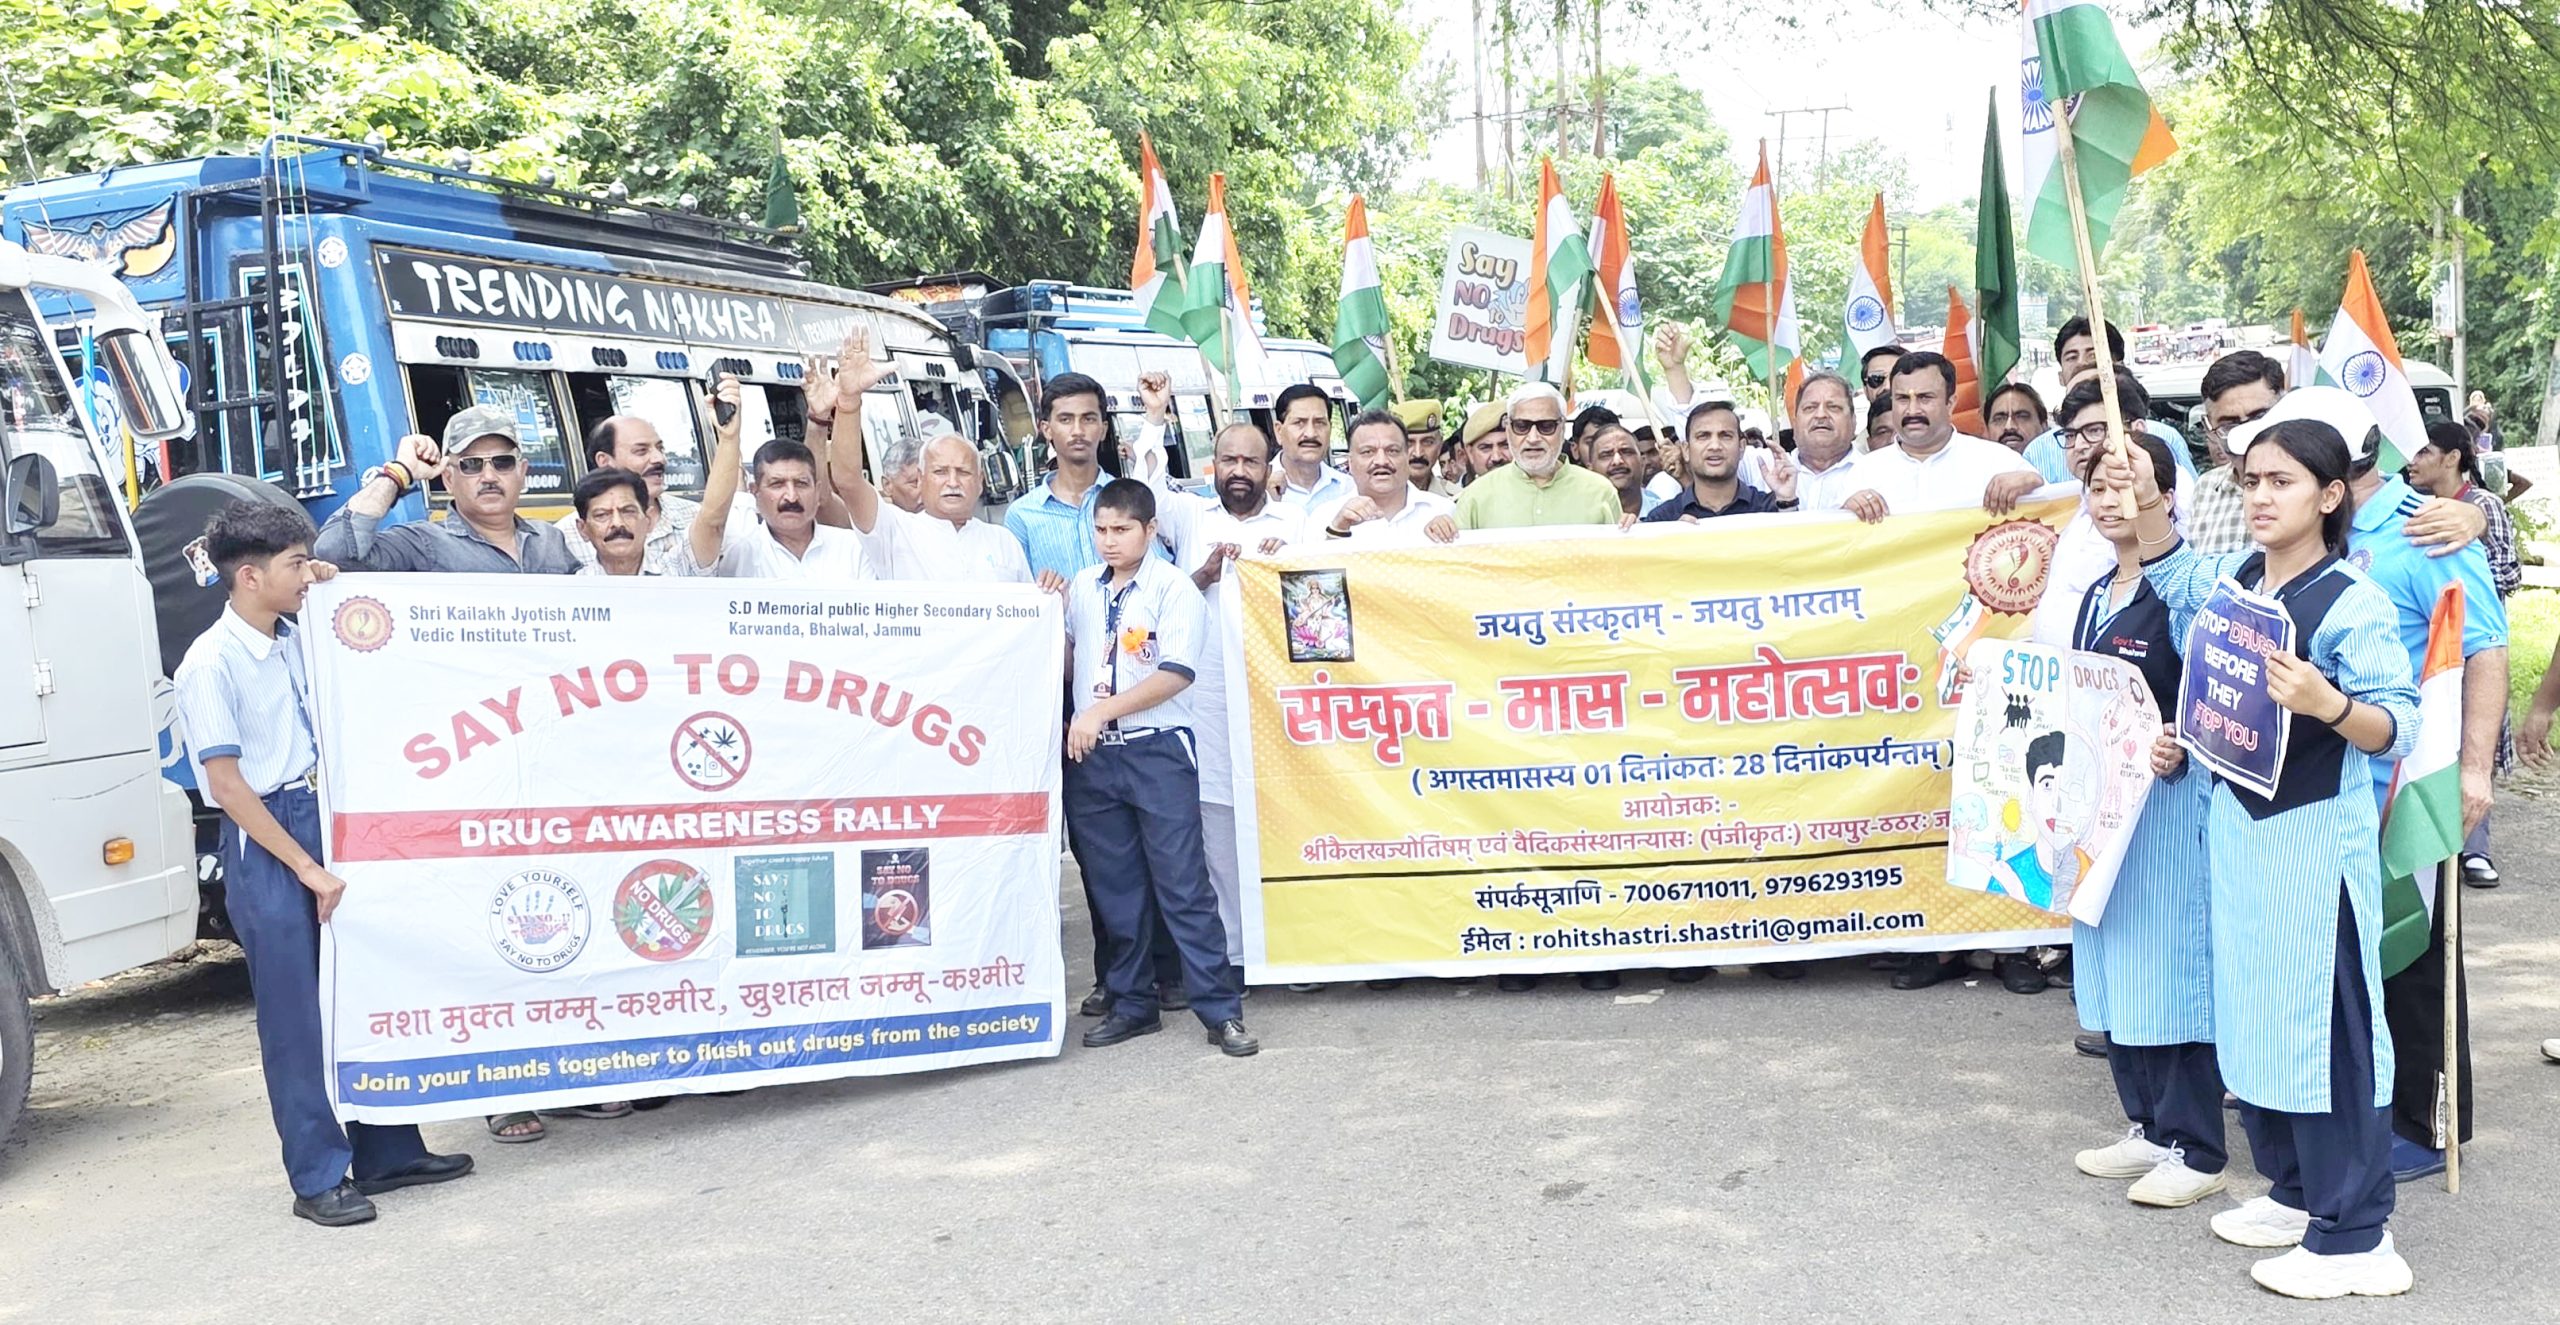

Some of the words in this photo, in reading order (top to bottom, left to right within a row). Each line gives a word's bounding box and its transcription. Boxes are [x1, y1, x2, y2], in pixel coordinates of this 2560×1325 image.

[1458, 241, 1517, 290] Say
[412, 261, 637, 332] TRENDING
[643, 288, 776, 342] NAKHRA
[1453, 279, 1491, 310] NO
[1488, 307, 1505, 324] to
[1448, 312, 1526, 356] Drugs
[521, 474, 562, 493] ueen
[409, 605, 441, 621] Shri
[447, 605, 506, 622] Kailakh
[511, 606, 567, 623] Jyotish
[572, 607, 611, 622] AVIM
[729, 601, 752, 616] S.D
[757, 601, 823, 617] Memorial
[828, 602, 870, 618] public
[875, 603, 919, 619] Higher
[923, 604, 992, 620] Secondary
[996, 604, 1041, 619] School
[729, 621, 805, 638] Karwanda,
[809, 622, 869, 638] Bhalwal,
[873, 622, 922, 637] Jammu
[1475, 610, 1547, 645] जयतु
[1550, 602, 1667, 641] संस्कृतम्
[1690, 596, 1765, 631] जयतु
[1769, 587, 1864, 621] भारतम्
[2199, 608, 2230, 636] STOP
[410, 628, 455, 643] Vedic
[461, 628, 527, 644] Institute
[532, 629, 577, 644] Trust.
[2002, 649, 2060, 692] STOP
[2074, 665, 2120, 691] DRUGS
[2204, 642, 2259, 686] BEFORE
[2207, 676, 2243, 711] THEY
[403, 686, 526, 779] SAY
[550, 659, 648, 717] NO
[673, 652, 760, 696] TO
[784, 660, 986, 767] DRUGS
[1279, 672, 1453, 763] संस्कृत
[1500, 674, 1628, 732] मास
[2192, 699, 2222, 732] STOP
[2224, 717, 2258, 751] YOU
[1428, 765, 1576, 789] अगस्तमासस्य
[1584, 764, 1611, 785] 01
[1733, 754, 1765, 777] 28
[1772, 738, 1941, 774] दिनांकपर्यन्तम्
[460, 816, 572, 848] DRUG
[585, 808, 821, 842] AWARENESS
[833, 803, 944, 834] RALLY
[1477, 832, 1507, 855] एवं
[753, 873, 778, 887] SAY
[897, 865, 912, 875] NO
[1475, 879, 1601, 914] संपर्कसूत्राणि
[1624, 880, 1758, 903] 7006711011,
[1765, 867, 1903, 896] 9796293195
[493, 882, 516, 915] LOVE
[521, 872, 584, 911] YOURSELF
[629, 880, 650, 901] NO
[647, 898, 692, 945] DRUGS
[754, 891, 776, 903] NO
[755, 908, 774, 920] TO
[499, 938, 517, 957] SAY
[517, 954, 533, 966] NO
[536, 958, 551, 967] TO
[553, 934, 581, 963] DRUGS
[755, 922, 806, 937] DRUGS
[1461, 925, 1512, 954] ईमेल
[1533, 911, 1925, 952] rohitshastri.shastri1@gmail.com
[369, 1009, 433, 1039] नशा
[440, 1002, 515, 1044] मुक्त
[525, 978, 728, 1031] जम्मू-कश्मीर,
[738, 976, 850, 1018] खुशहाल
[859, 955, 1026, 1004] जम्मू-कश्मीर
[352, 1072, 412, 1092] Join
[417, 1069, 471, 1094] your
[477, 1058, 551, 1083] hands
[557, 1048, 661, 1076] together
[665, 1046, 691, 1064] to
[697, 1037, 752, 1061] flush
[758, 1037, 796, 1056] out
[802, 1030, 865, 1053] drugs
[871, 1027, 921, 1045] from
[927, 1022, 960, 1040] the
[966, 1014, 1041, 1037] society
